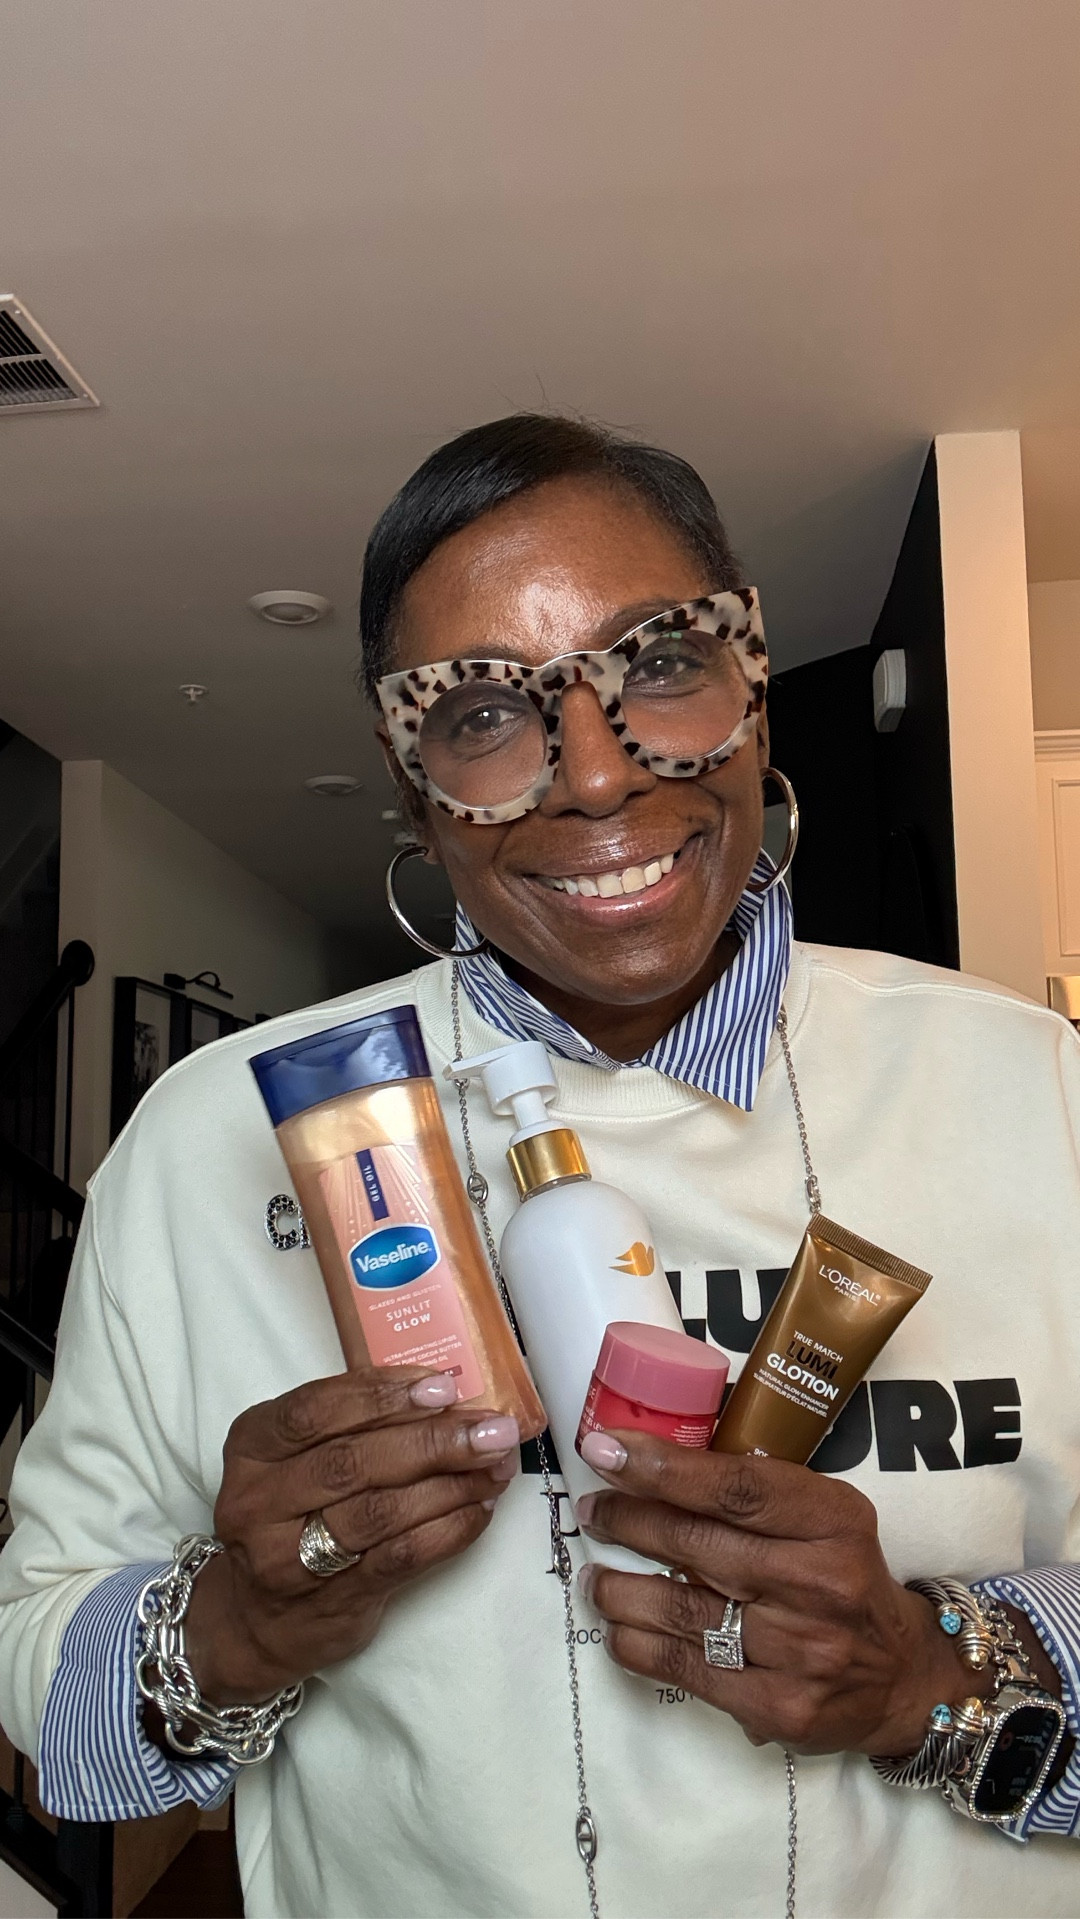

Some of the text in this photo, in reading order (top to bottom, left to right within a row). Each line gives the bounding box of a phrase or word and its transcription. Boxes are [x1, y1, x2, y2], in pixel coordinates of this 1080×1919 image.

[355, 1241, 431, 1273] Vaseline
[818, 1264, 880, 1306] L'ORÉAL
[834, 1285, 857, 1302] PARIS
[386, 1299, 431, 1322] SUNLIT
[393, 1313, 431, 1332] GLOW
[417, 1349, 439, 1361] COCOA
[439, 1341, 463, 1354] BUTTER
[785, 1341, 838, 1379] LUMI
[793, 1330, 844, 1363] TRUE MATCH
[753, 1372, 788, 1397] SUBLIMATEUR
[758, 1368, 830, 1410] NATURAL GLOW ENHANCER
[766, 1353, 840, 1401] GLOTION
